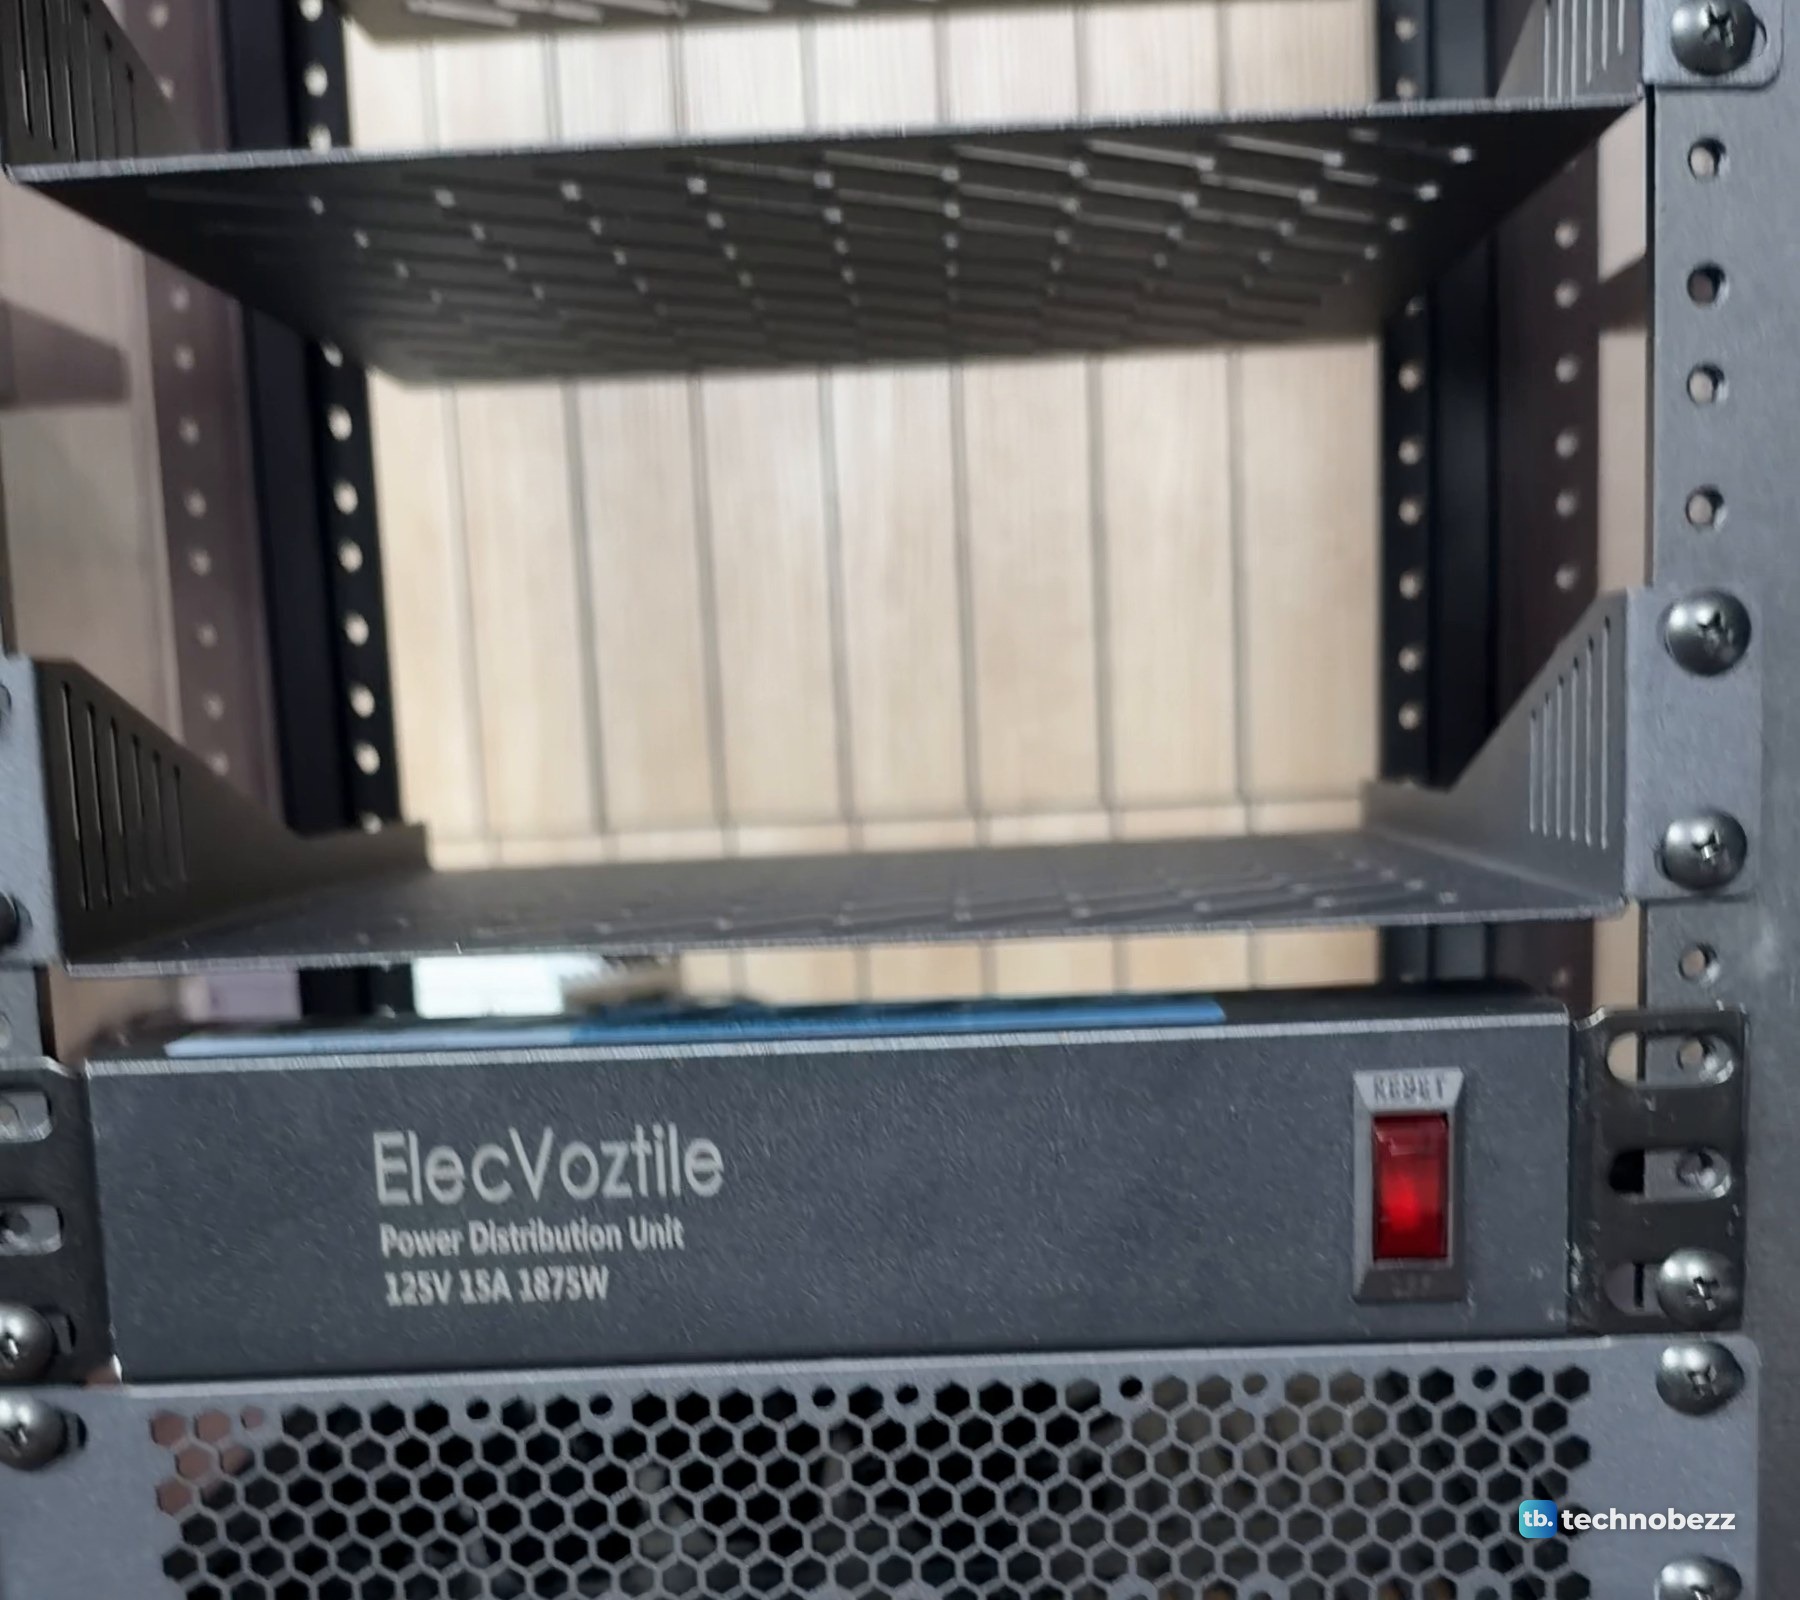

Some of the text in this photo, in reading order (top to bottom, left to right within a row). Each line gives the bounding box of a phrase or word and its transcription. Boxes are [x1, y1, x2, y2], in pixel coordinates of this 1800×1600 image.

[1373, 1073, 1447, 1102] RESET
[373, 1121, 725, 1206] ElecVoztile
[379, 1213, 686, 1258] Power Distribution Unit
[384, 1264, 610, 1307] 125V 15A 1875W
